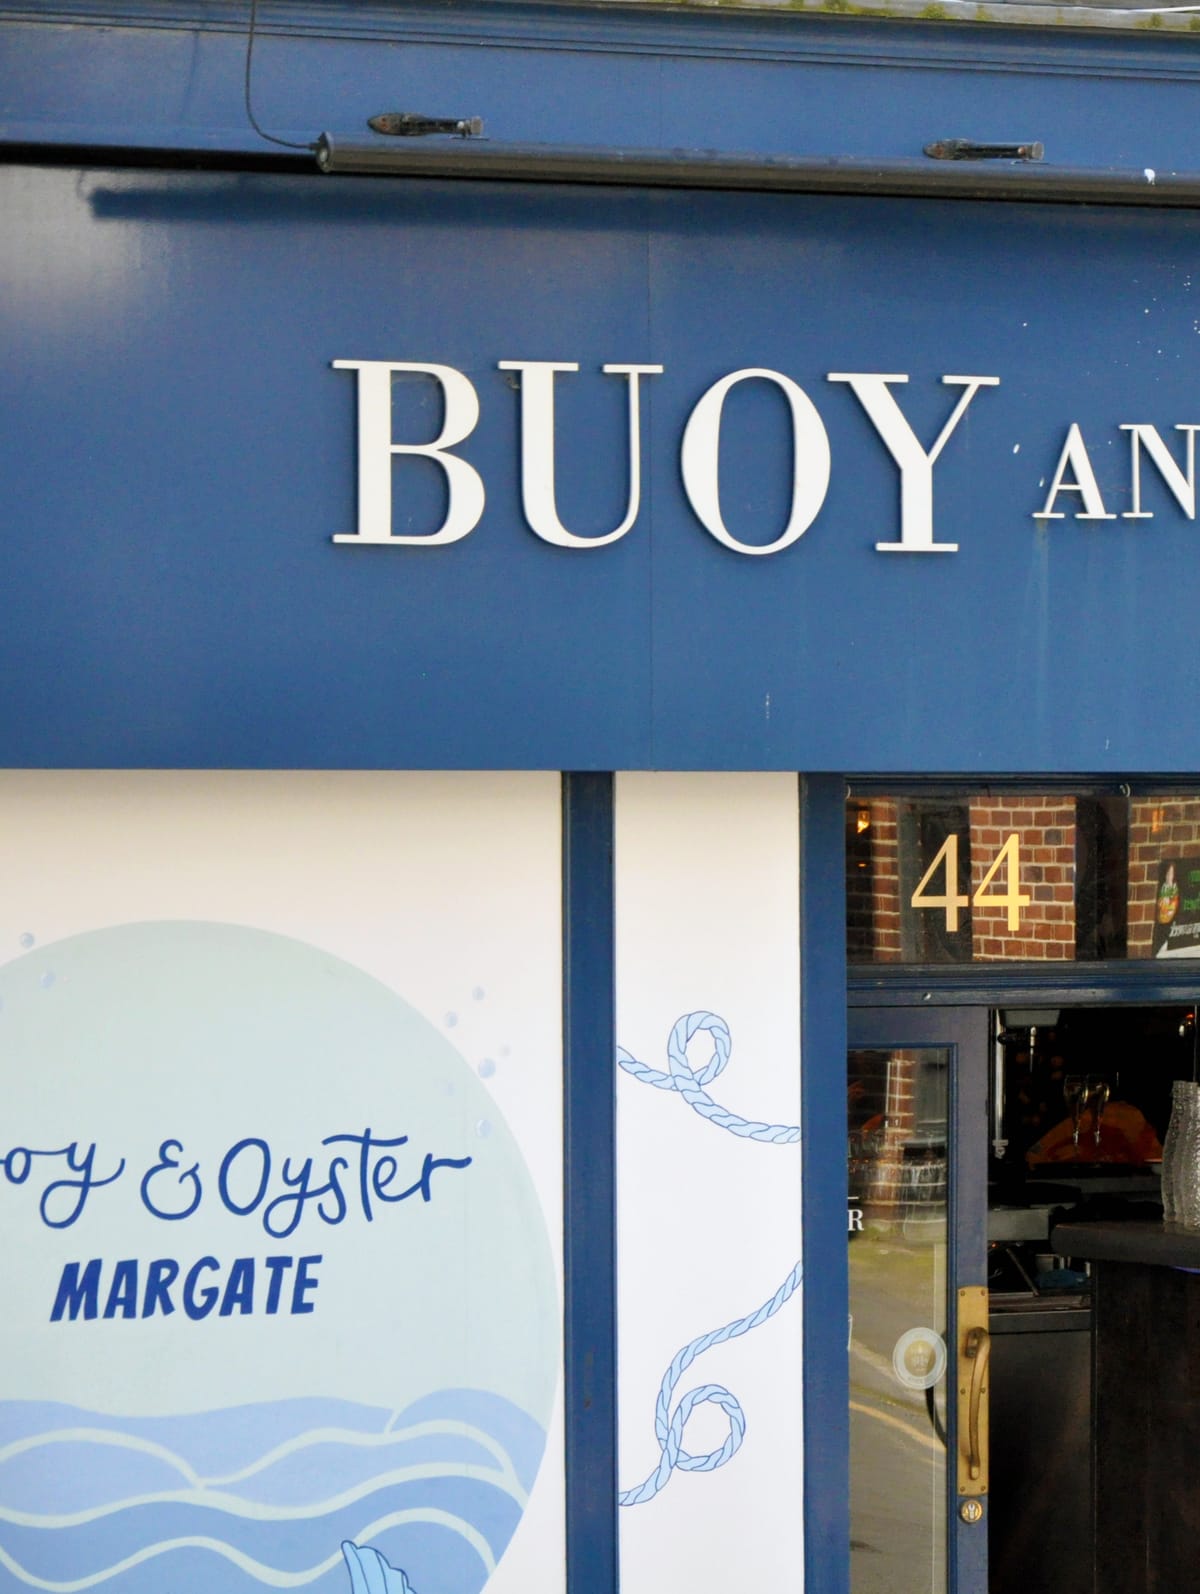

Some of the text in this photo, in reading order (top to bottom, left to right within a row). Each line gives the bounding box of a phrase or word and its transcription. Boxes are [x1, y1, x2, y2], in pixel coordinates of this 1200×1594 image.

[332, 359, 1000, 555] BUOY
[911, 833, 1030, 932] 44
[0, 1128, 472, 1239] oy & Oyster
[50, 1254, 323, 1322] MARGATE
